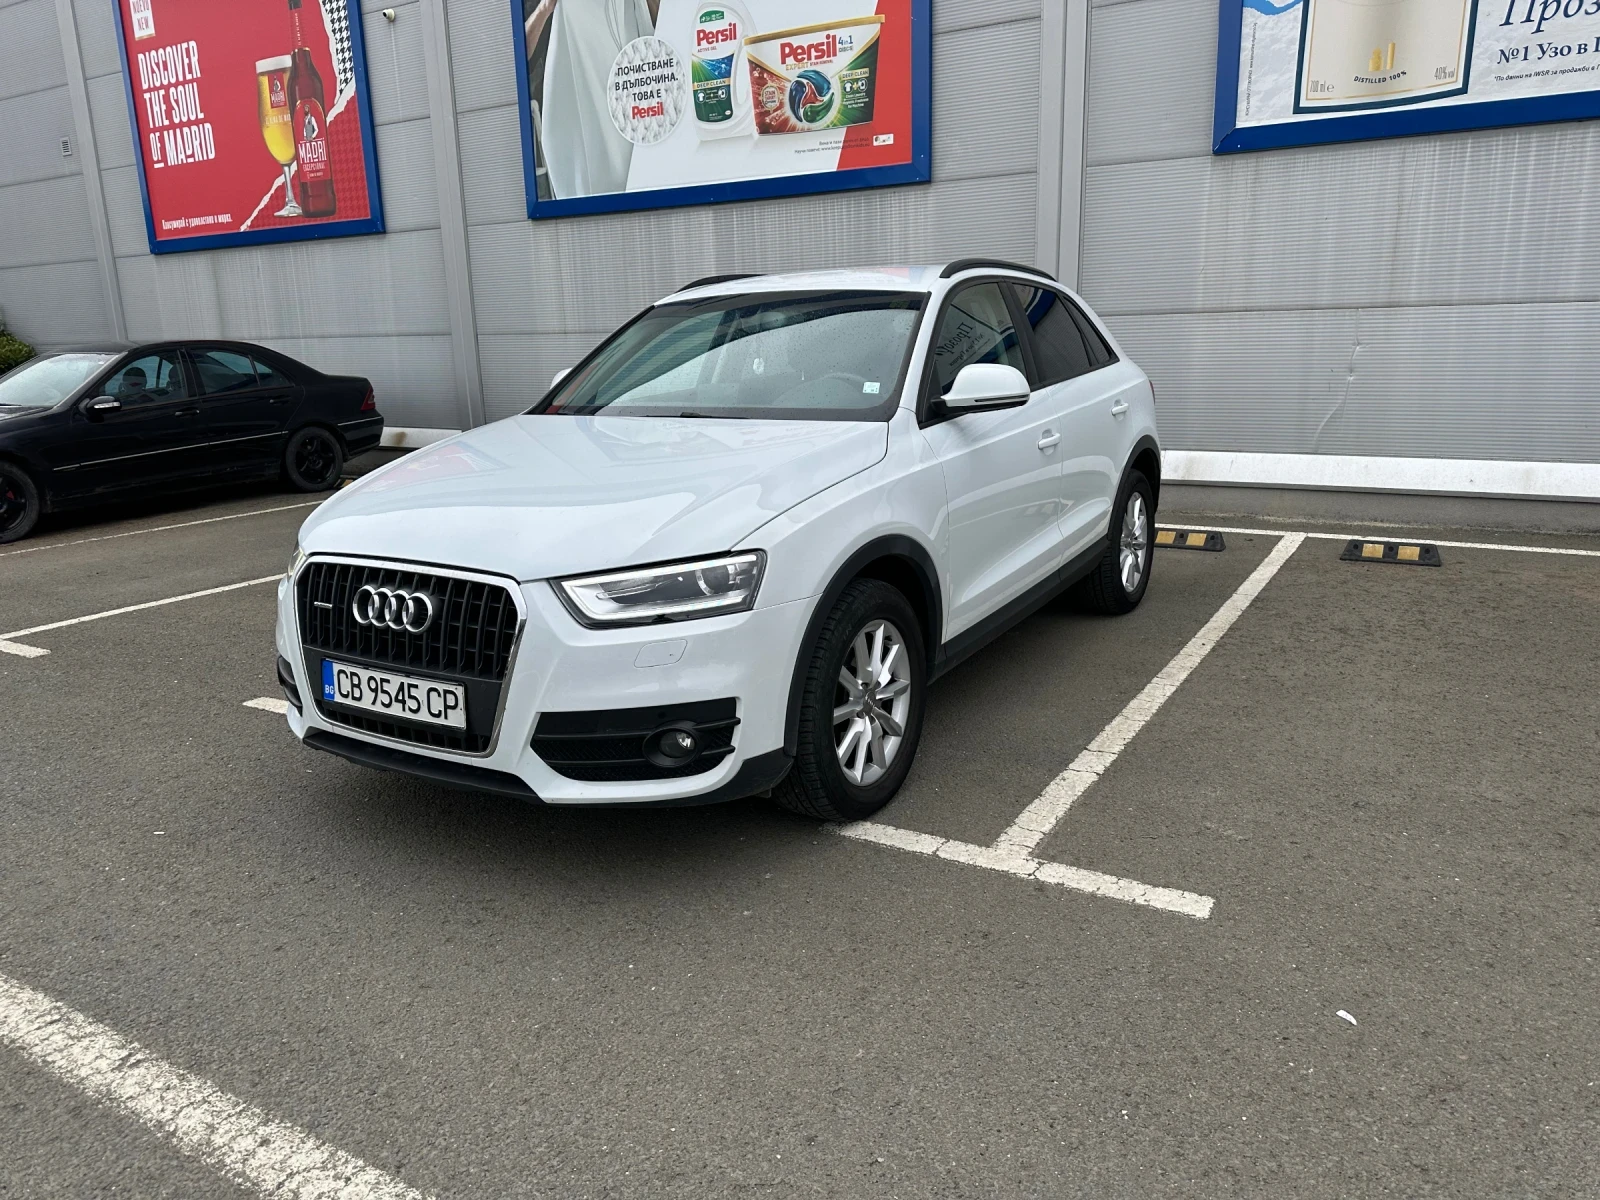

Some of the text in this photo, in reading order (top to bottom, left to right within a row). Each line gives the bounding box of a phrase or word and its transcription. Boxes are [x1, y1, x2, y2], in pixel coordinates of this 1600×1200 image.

[137, 16, 150, 31] NEW
[696, 22, 736, 46] Persil
[780, 34, 838, 64] Persil
[1536, 42, 1572, 60] Узо
[1576, 43, 1588, 55] в
[137, 40, 202, 90] DISCOVER
[618, 58, 674, 76] ПОЧИСТВАНЕ
[786, 62, 809, 71] EXPERT
[1434, 66, 1448, 80] 40%
[615, 72, 678, 92] В ДЪЛБОЧИНА.
[1310, 80, 1320, 92] 700
[1354, 70, 1407, 84] DISTILLED 100%
[632, 89, 662, 102] ТОВА Е
[144, 82, 204, 128] THE SOUL
[632, 101, 664, 119] Persil
[150, 123, 216, 166] OF MADRID
[325, 684, 334, 694] BG
[337, 669, 459, 720] CB 9545 CP
